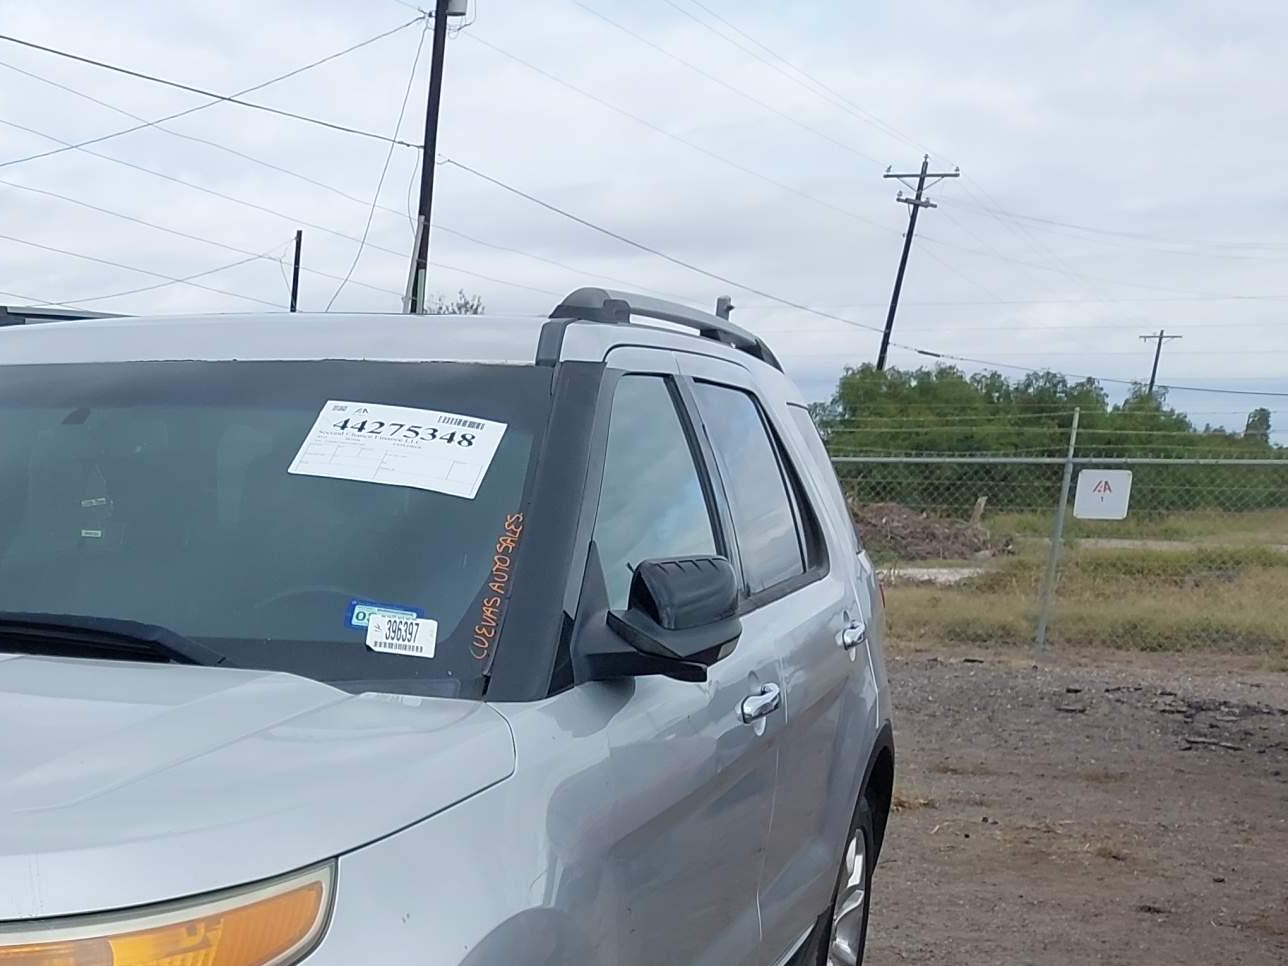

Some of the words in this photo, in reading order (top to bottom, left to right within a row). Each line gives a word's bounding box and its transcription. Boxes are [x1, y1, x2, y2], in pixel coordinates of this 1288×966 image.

[333, 417, 476, 448] 44275348
[469, 596, 501, 659] CUEVAS
[488, 555, 511, 594] AUTO
[385, 619, 420, 643] 396397
